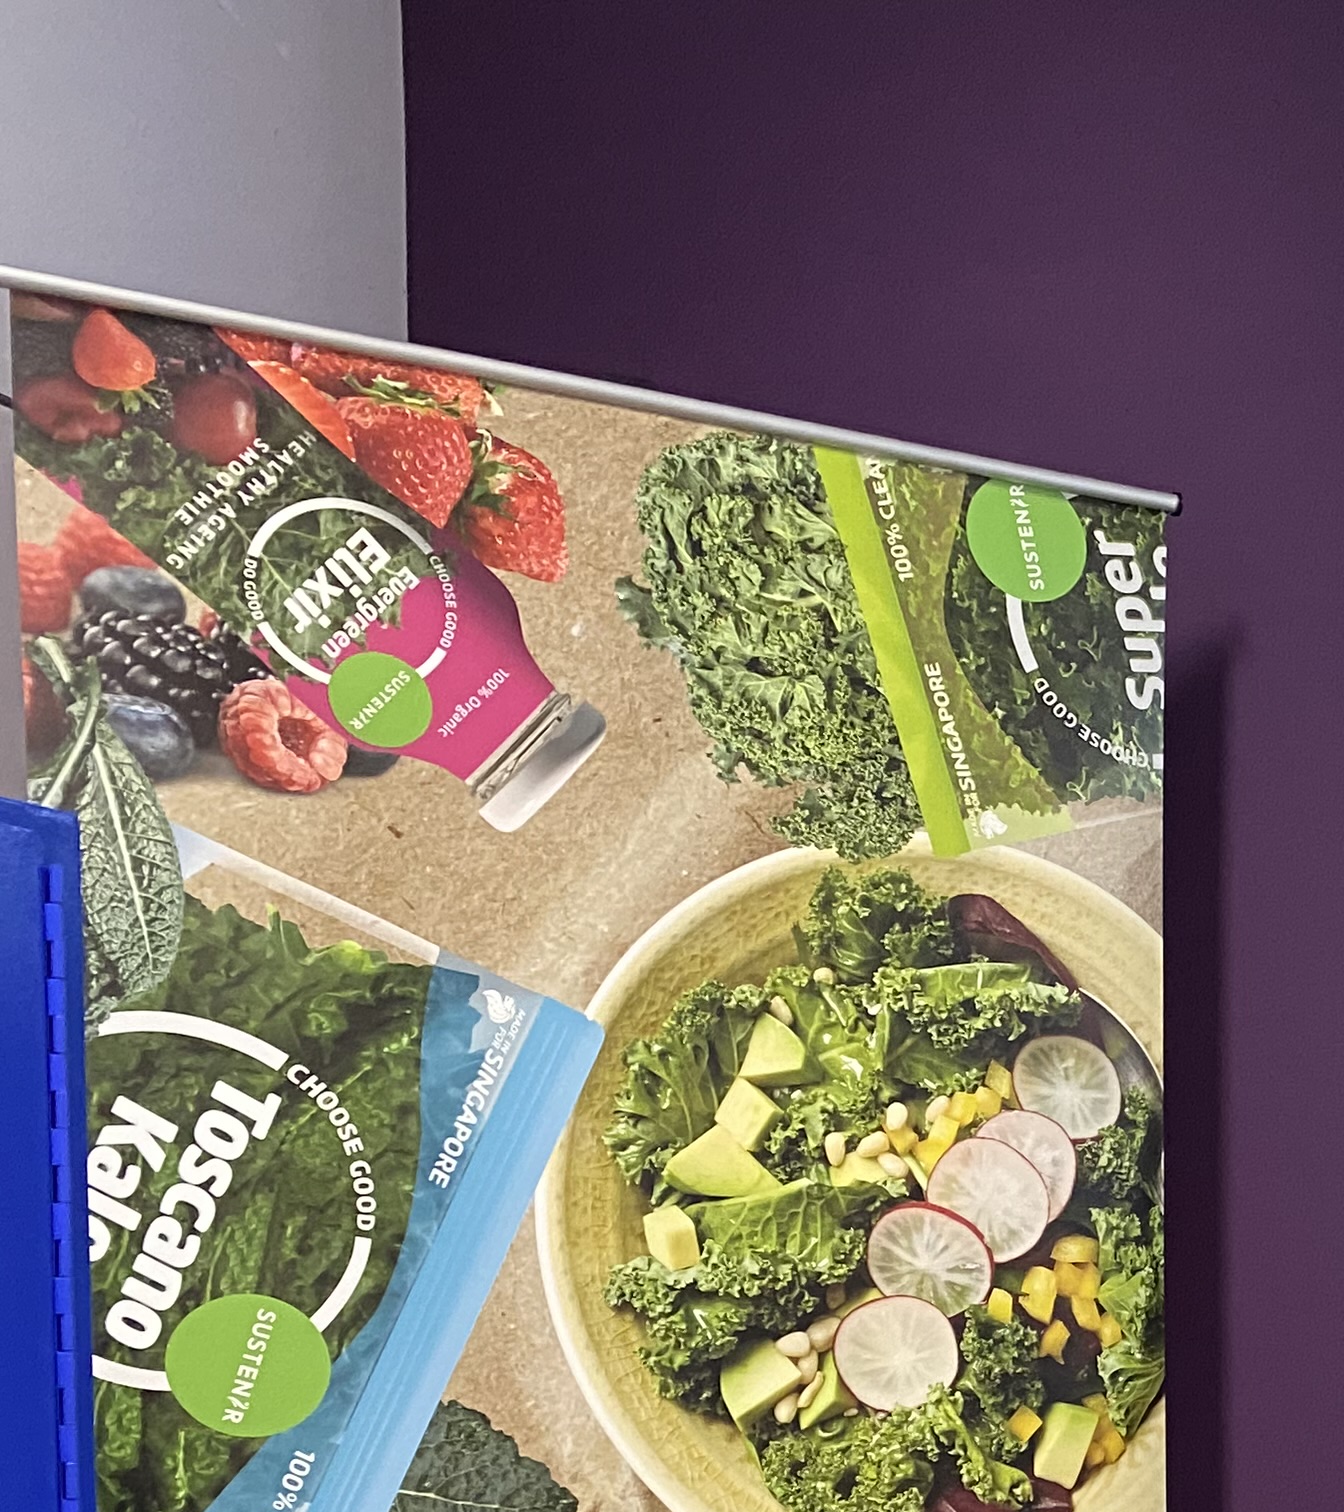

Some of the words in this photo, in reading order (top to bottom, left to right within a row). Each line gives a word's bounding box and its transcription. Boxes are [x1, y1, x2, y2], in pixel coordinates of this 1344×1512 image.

[174, 436, 272, 527] SMOOTHIE
[238, 432, 318, 510] HEALTHY
[166, 504, 240, 572] AGEING
[281, 527, 392, 636] Elixir
[1009, 484, 1045, 592] SUSTENIR
[320, 564, 422, 660] Evergreen
[1094, 530, 1165, 711] Super
[284, 1063, 365, 1157] CHOOSE
[350, 1158, 377, 1232] GOOD
[427, 1046, 504, 1190] SINGAPORE
[105, 1079, 283, 1350] Toscano
[221, 1307, 277, 1425] SUSTENIR
[270, 1450, 317, 1512] 100%
